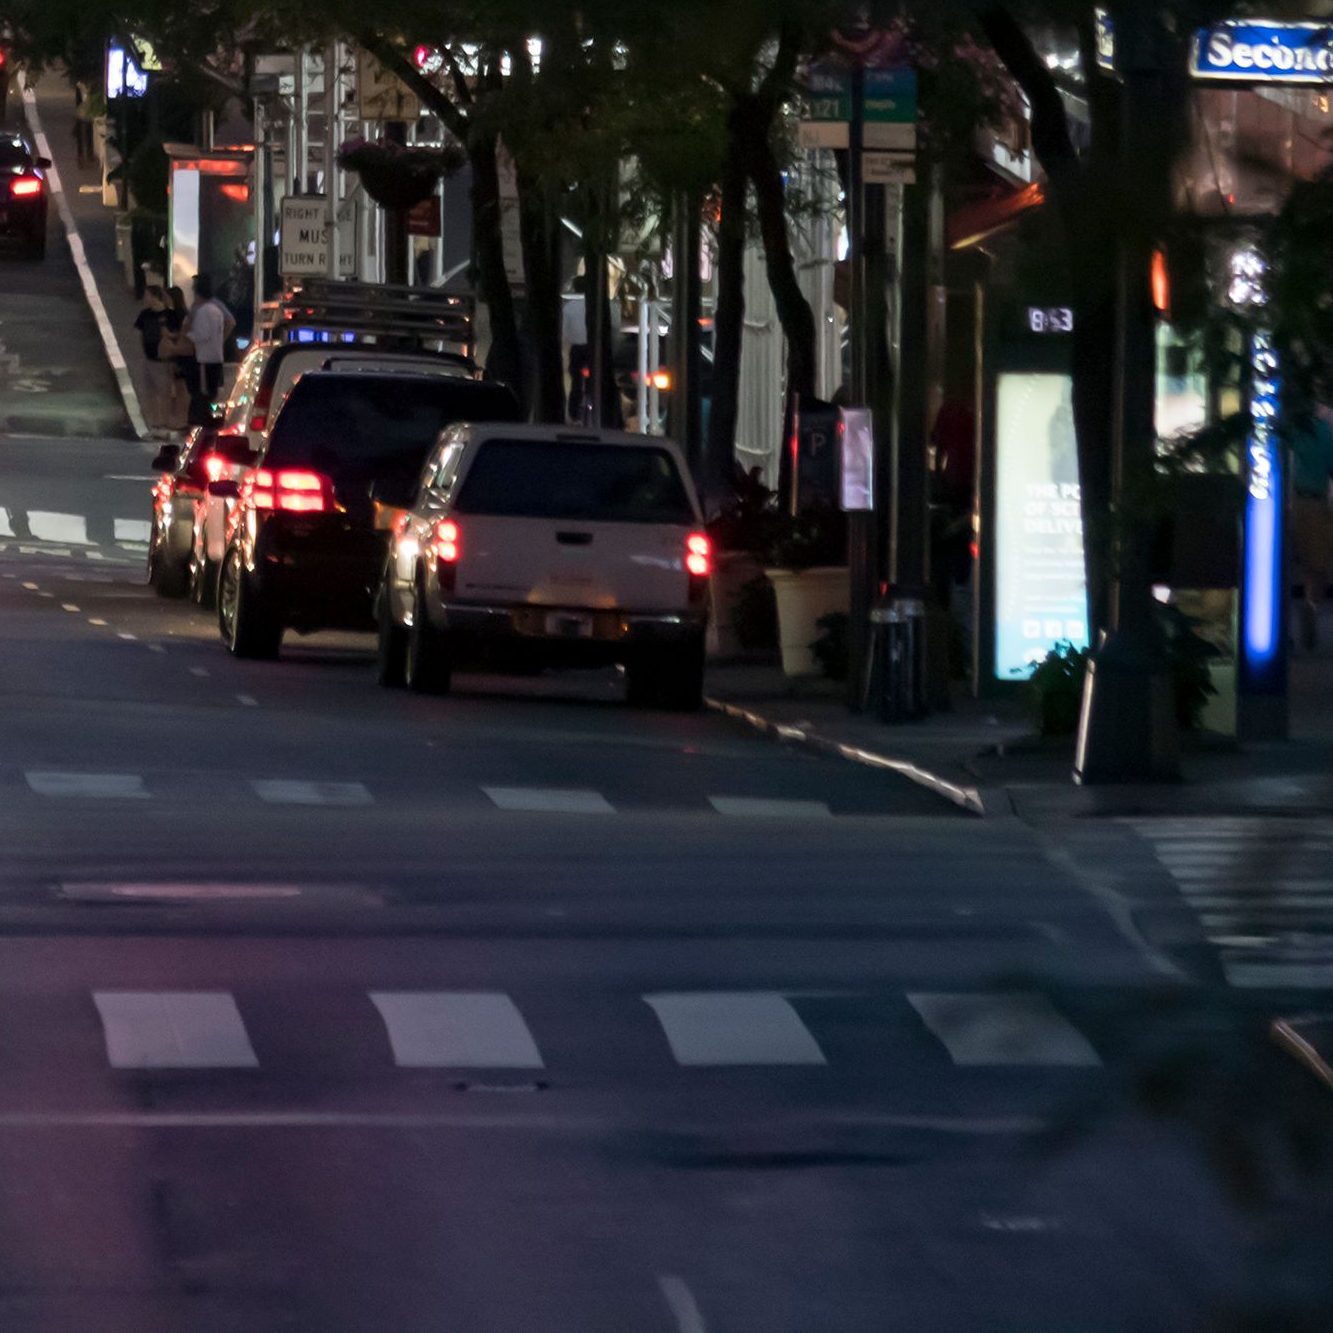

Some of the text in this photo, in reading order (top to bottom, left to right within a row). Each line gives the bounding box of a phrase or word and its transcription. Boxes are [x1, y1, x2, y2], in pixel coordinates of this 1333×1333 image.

[286, 208, 319, 220] RIGHT
[299, 230, 329, 244] MUS
[285, 253, 353, 266] TURN RHT
